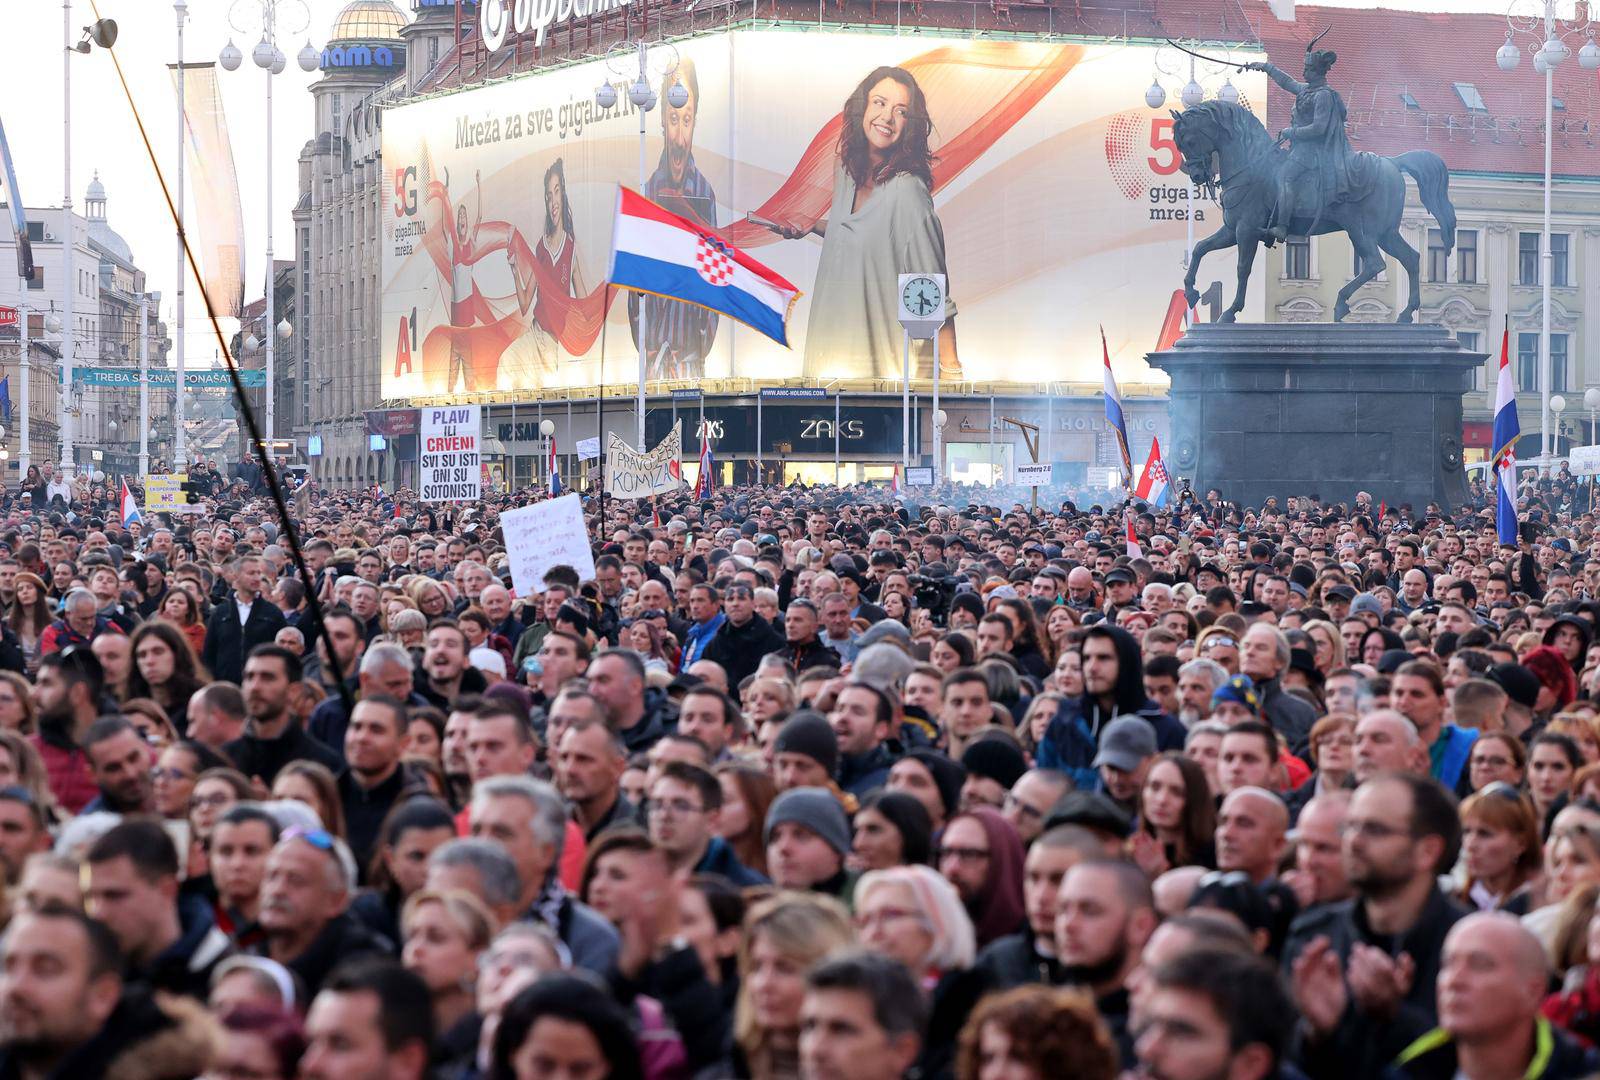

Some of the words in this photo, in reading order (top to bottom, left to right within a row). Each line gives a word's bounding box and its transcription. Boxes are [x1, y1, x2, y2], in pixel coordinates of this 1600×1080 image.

[320, 47, 393, 67] nama
[455, 109, 501, 149] Mreža
[505, 114, 522, 139] za
[527, 107, 553, 135] sve
[394, 166, 418, 217] 5G
[394, 220, 427, 242] gigaBITNA
[394, 306, 417, 378] A1
[93, 372, 130, 382] TREBA
[148, 374, 177, 383] ZNAT
[183, 372, 233, 383] PONAŠAT
[432, 409, 470, 424] PLAVI
[444, 425, 457, 437] ILI
[801, 420, 864, 439] ZAKS
[427, 436, 474, 452] CRVENI
[422, 455, 438, 468] SVI
[442, 454, 456, 467] SU
[460, 453, 478, 466] ISTI
[433, 469, 451, 483] ONI
[454, 468, 467, 481] SU
[424, 484, 476, 499] SOTONISTI
